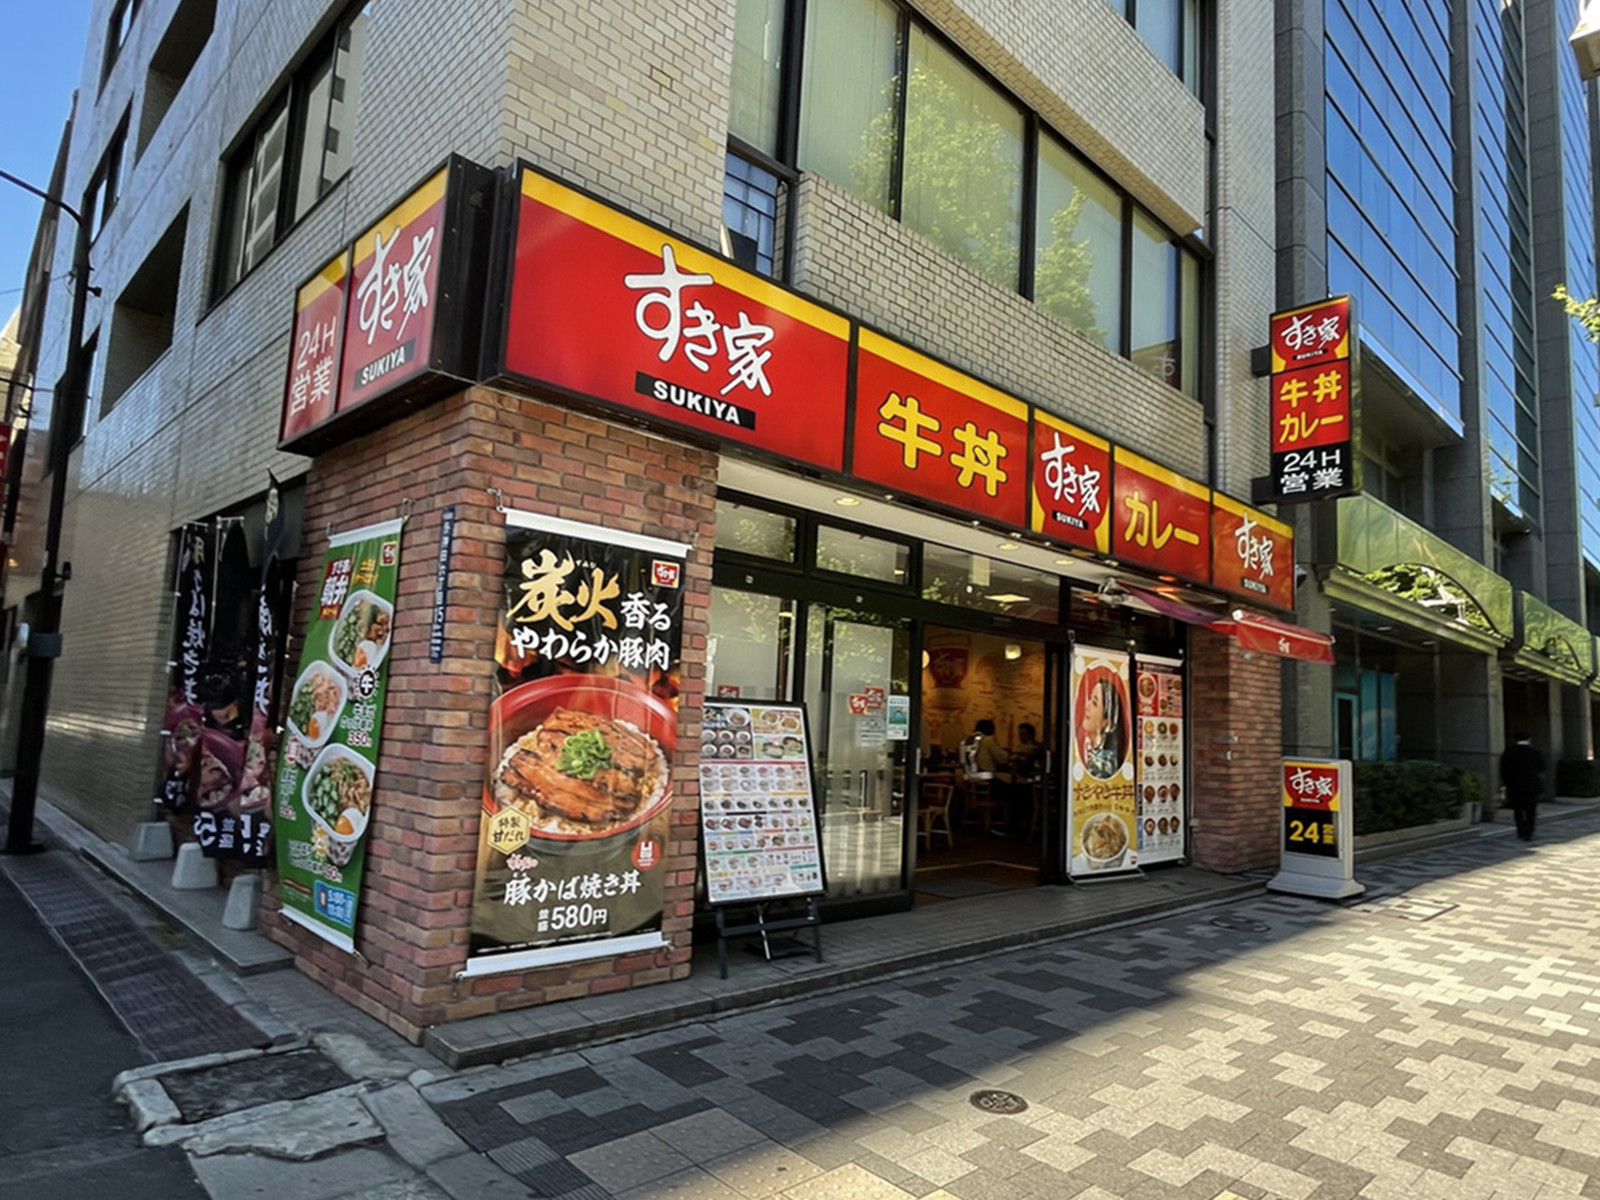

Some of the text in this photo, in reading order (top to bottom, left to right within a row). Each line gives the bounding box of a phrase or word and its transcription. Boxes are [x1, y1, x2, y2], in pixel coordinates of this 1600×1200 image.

[357, 226, 435, 345] すき家
[623, 243, 775, 397] すき家
[1281, 314, 1340, 350] すき家
[296, 316, 338, 369] 24H
[290, 356, 333, 417] 営業
[360, 347, 406, 386] SUKIYA
[653, 380, 741, 426] SUKIYA
[1280, 370, 1342, 408] 牛丼
[877, 391, 1008, 497] 牛丼
[1279, 411, 1344, 443] カレー
[1041, 431, 1100, 516] すき家
[1280, 467, 1343, 494] 営業
[1283, 449, 1341, 473] 24H
[1123, 490, 1200, 551] カレー
[1234, 509, 1274, 579] すき家
[509, 625, 671, 671] やわらか豚肉
[1289, 767, 1333, 798] すき家
[1289, 820, 1320, 843] 24
[503, 870, 642, 906] 豚かば焼き丼
[550, 903, 608, 930] 580円
